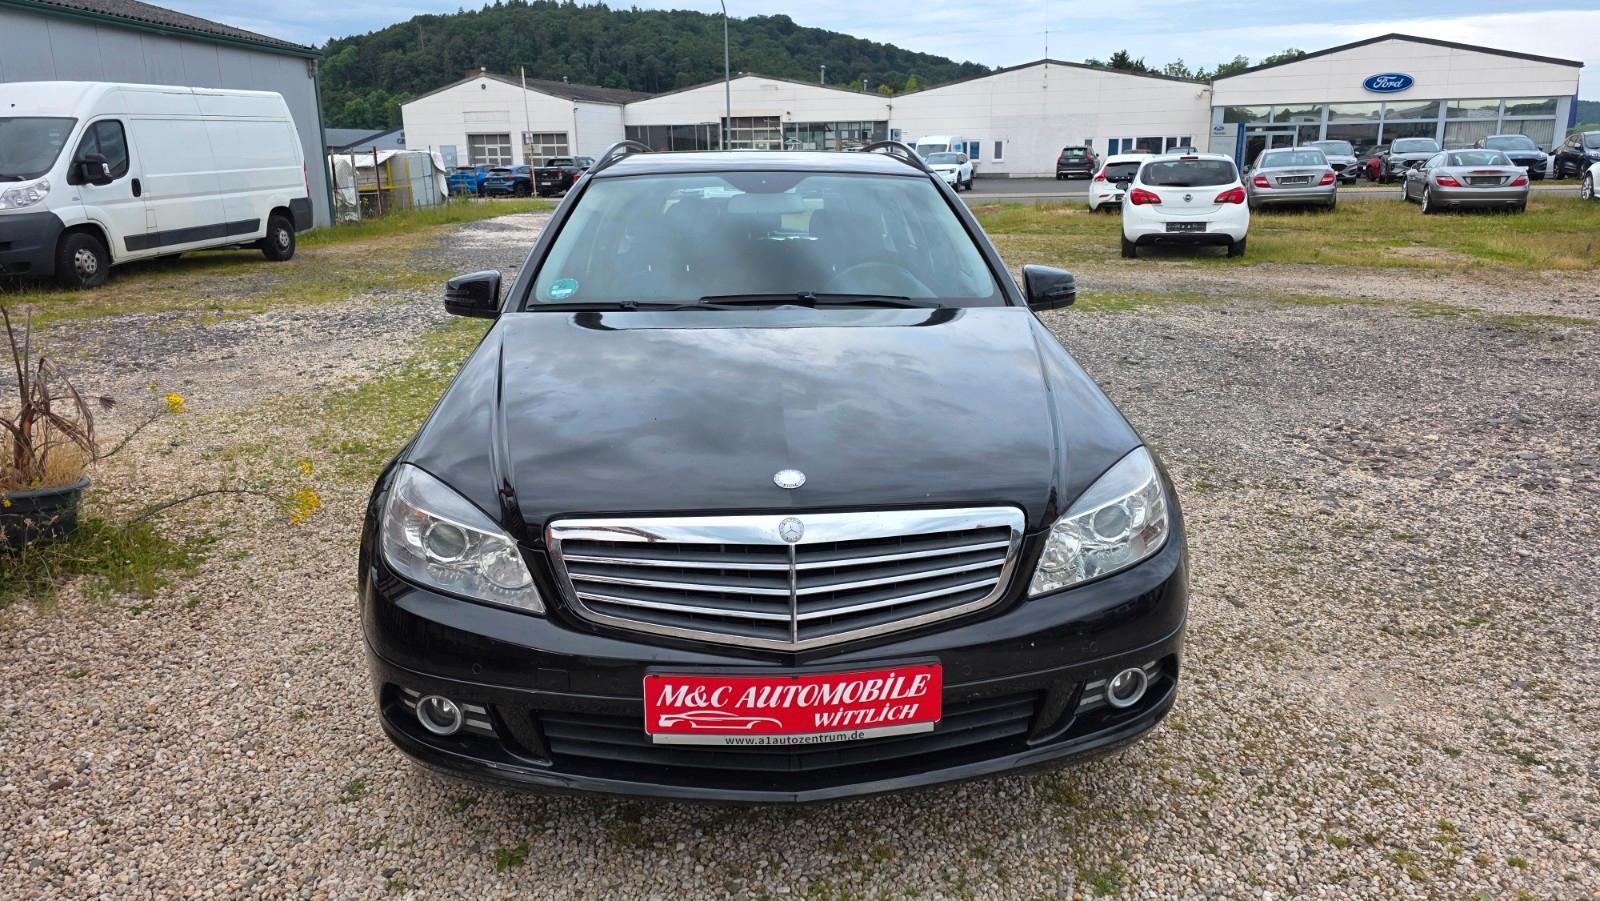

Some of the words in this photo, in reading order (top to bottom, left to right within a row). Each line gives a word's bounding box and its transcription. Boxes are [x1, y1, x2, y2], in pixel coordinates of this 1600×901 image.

[1373, 76, 1404, 88] Ford
[656, 684, 732, 708] M&C
[725, 730, 865, 746] www.a1autozentrum.de
